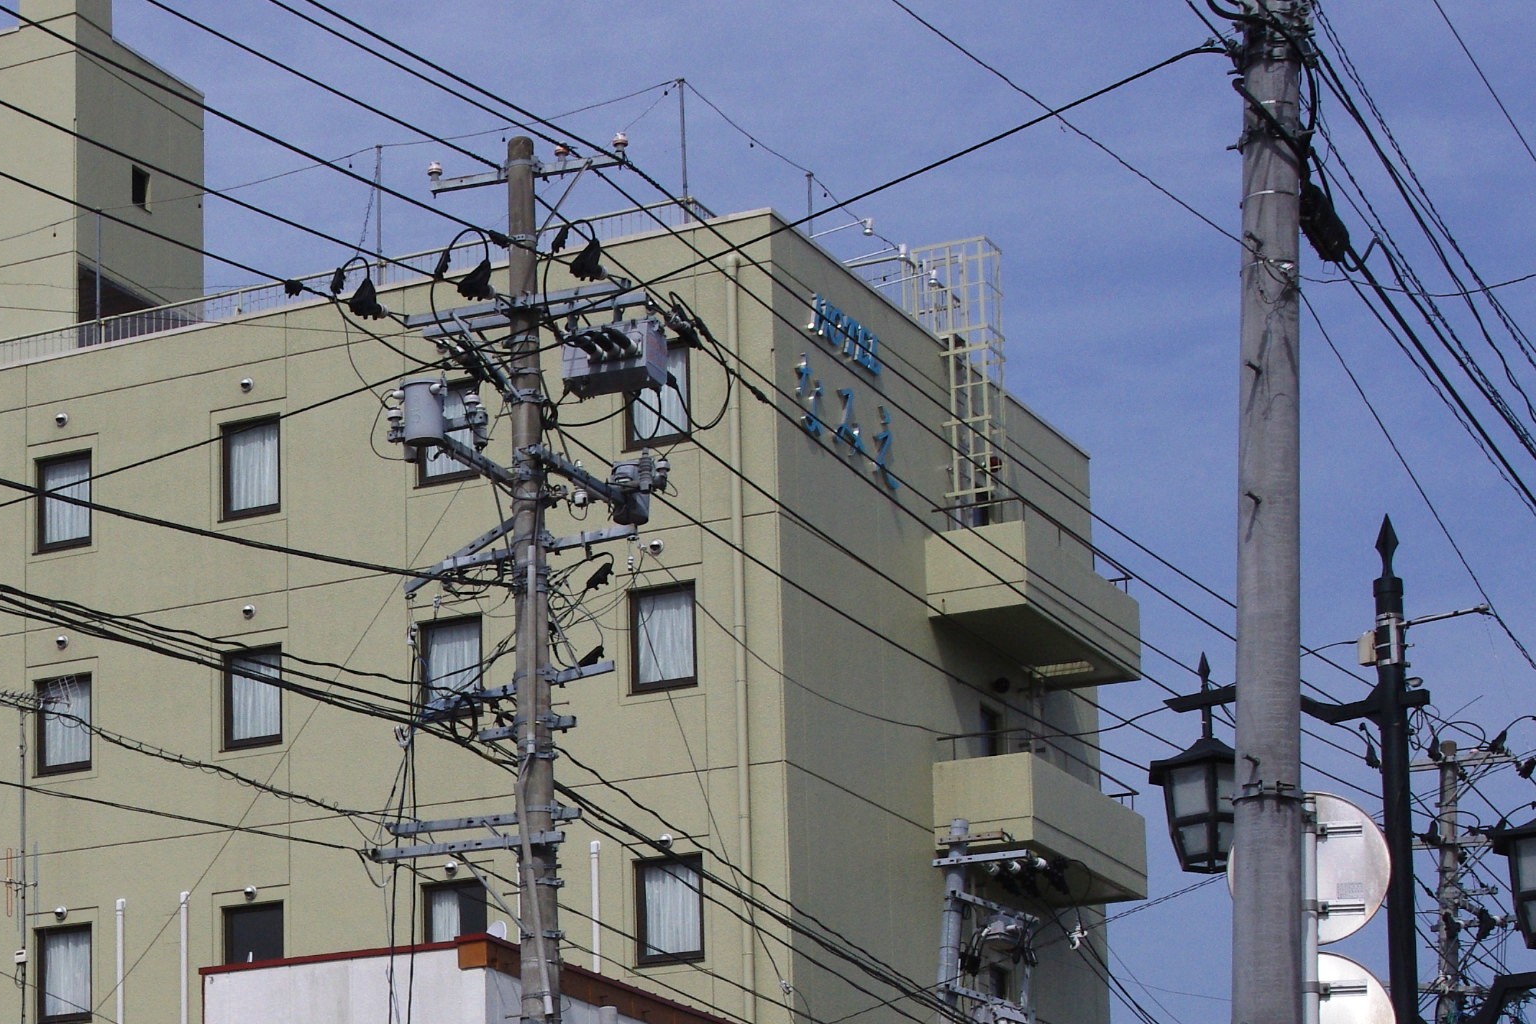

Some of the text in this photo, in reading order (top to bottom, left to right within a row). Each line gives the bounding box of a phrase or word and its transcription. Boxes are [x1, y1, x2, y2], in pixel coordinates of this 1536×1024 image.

[808, 293, 881, 376] HOTEL
[795, 353, 900, 490] なみえ
